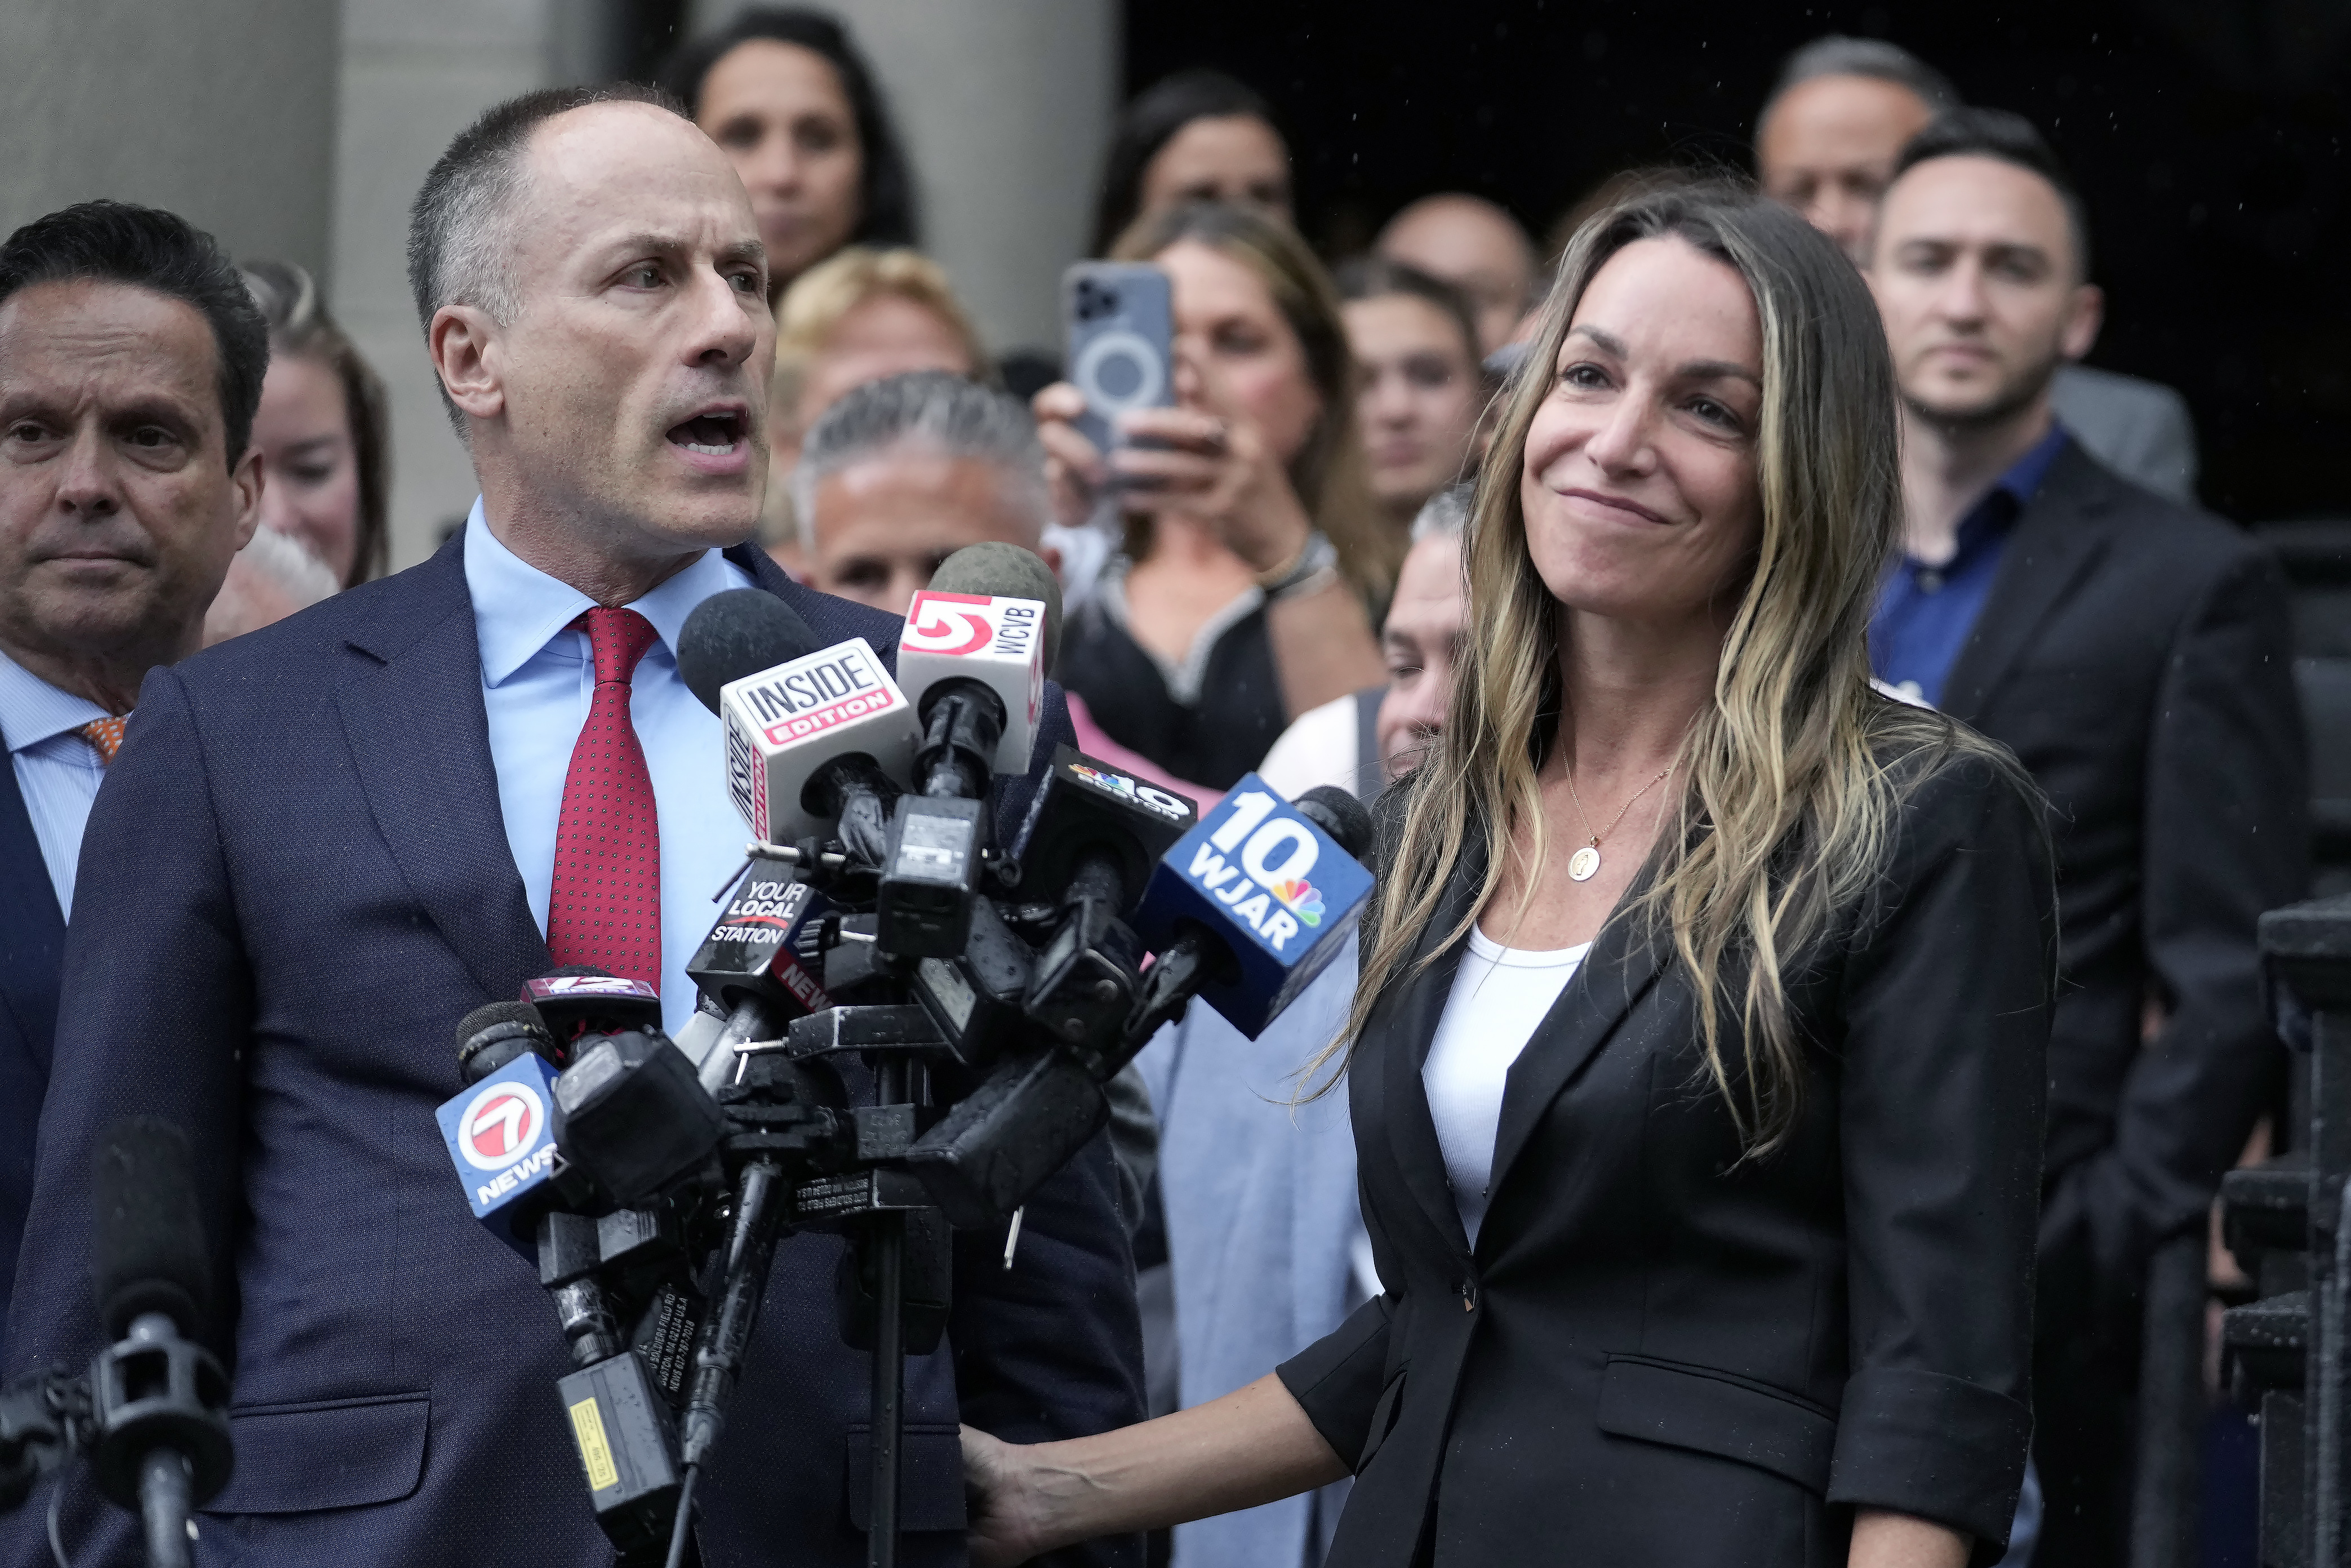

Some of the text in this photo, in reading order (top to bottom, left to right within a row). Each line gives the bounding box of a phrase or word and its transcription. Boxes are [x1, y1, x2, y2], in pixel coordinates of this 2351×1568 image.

[902, 590, 992, 655] 5
[994, 608, 1034, 654] WCVB
[747, 655, 874, 722] INSIDE
[772, 692, 888, 742] EDITION
[1077, 773, 1180, 821] BOSTON
[1111, 772, 1190, 816] 10
[1210, 791, 1319, 891] 10
[728, 899, 794, 918] LOCAL
[748, 881, 807, 901] YOUR
[1188, 842, 1299, 952] WJAR
[711, 925, 784, 944] STATION
[472, 1097, 527, 1153] 7
[477, 1142, 558, 1206] NEWS
